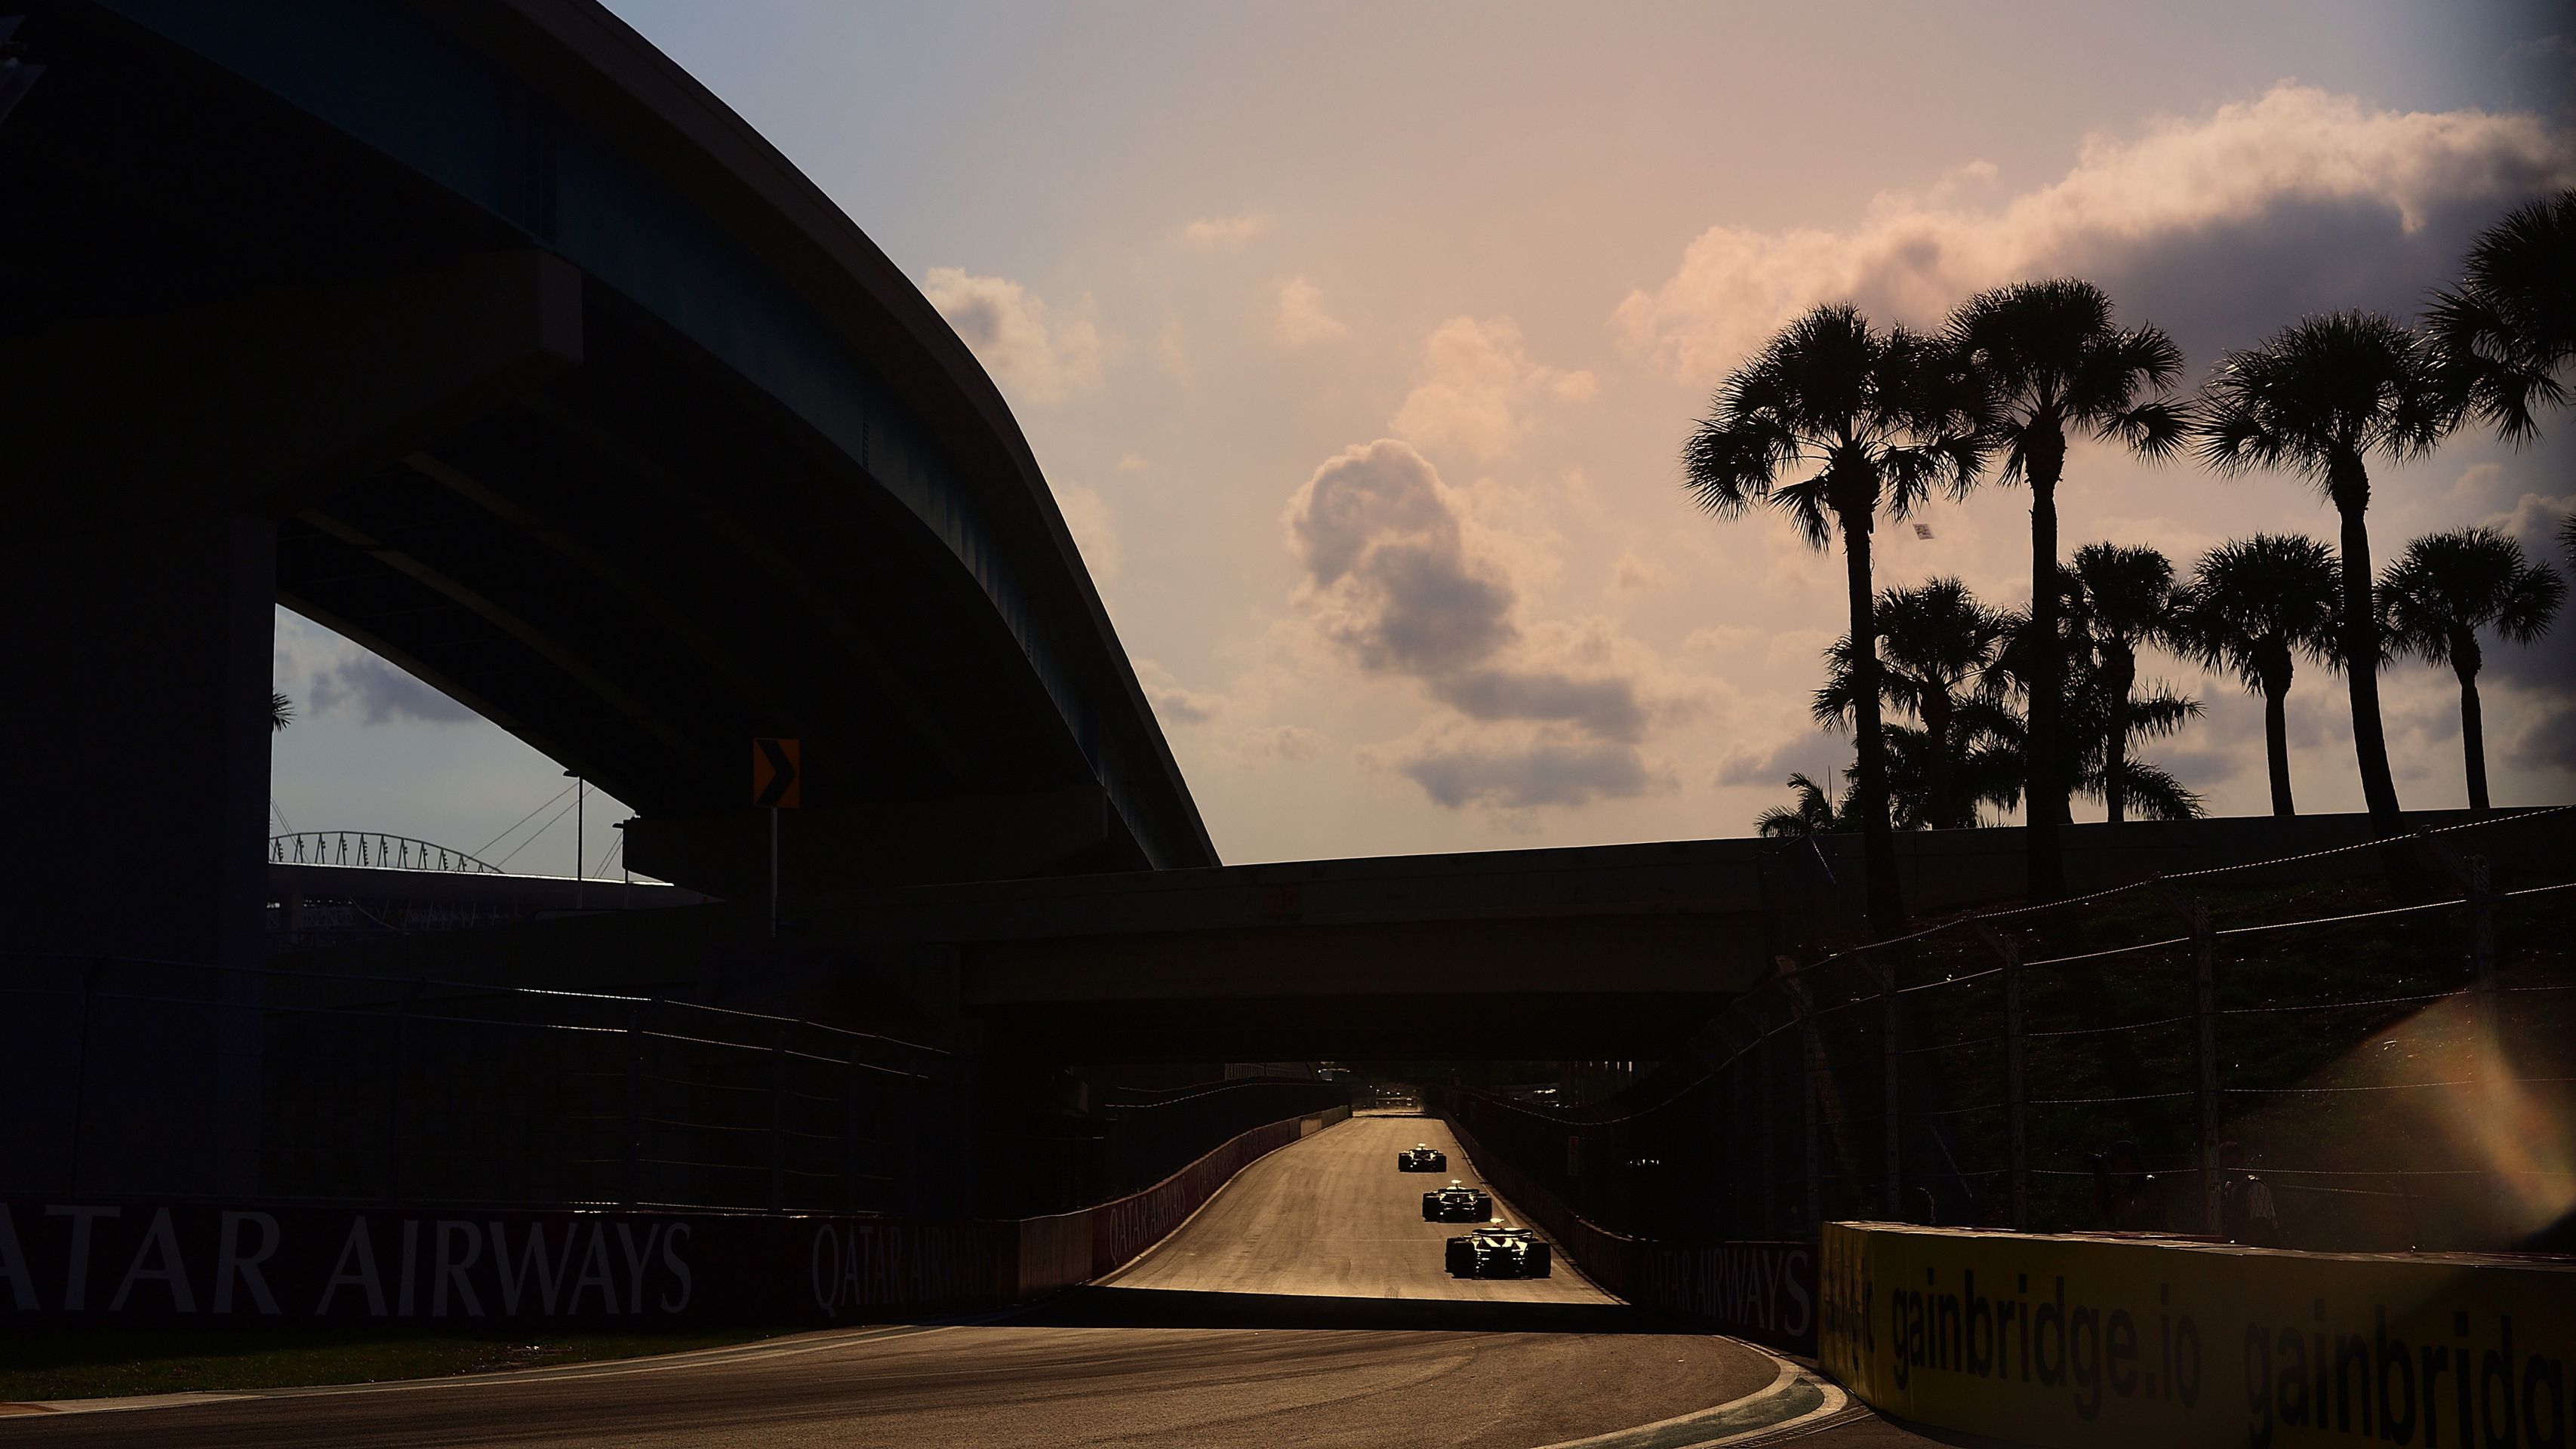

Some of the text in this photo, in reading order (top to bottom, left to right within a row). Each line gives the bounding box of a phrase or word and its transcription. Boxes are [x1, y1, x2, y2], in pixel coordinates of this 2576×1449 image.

[314, 1214, 693, 1317] AIRWAYS
[1109, 1177, 1186, 1265] QATAR AIRWAYS
[812, 1223, 904, 1318] QATAR
[1643, 1246, 1691, 1312] QATAR
[1695, 1247, 1811, 1337] AIRWAYS
[1892, 1267, 2200, 1423] gainbridge.io
[2244, 1297, 2576, 1449] gainbridg
